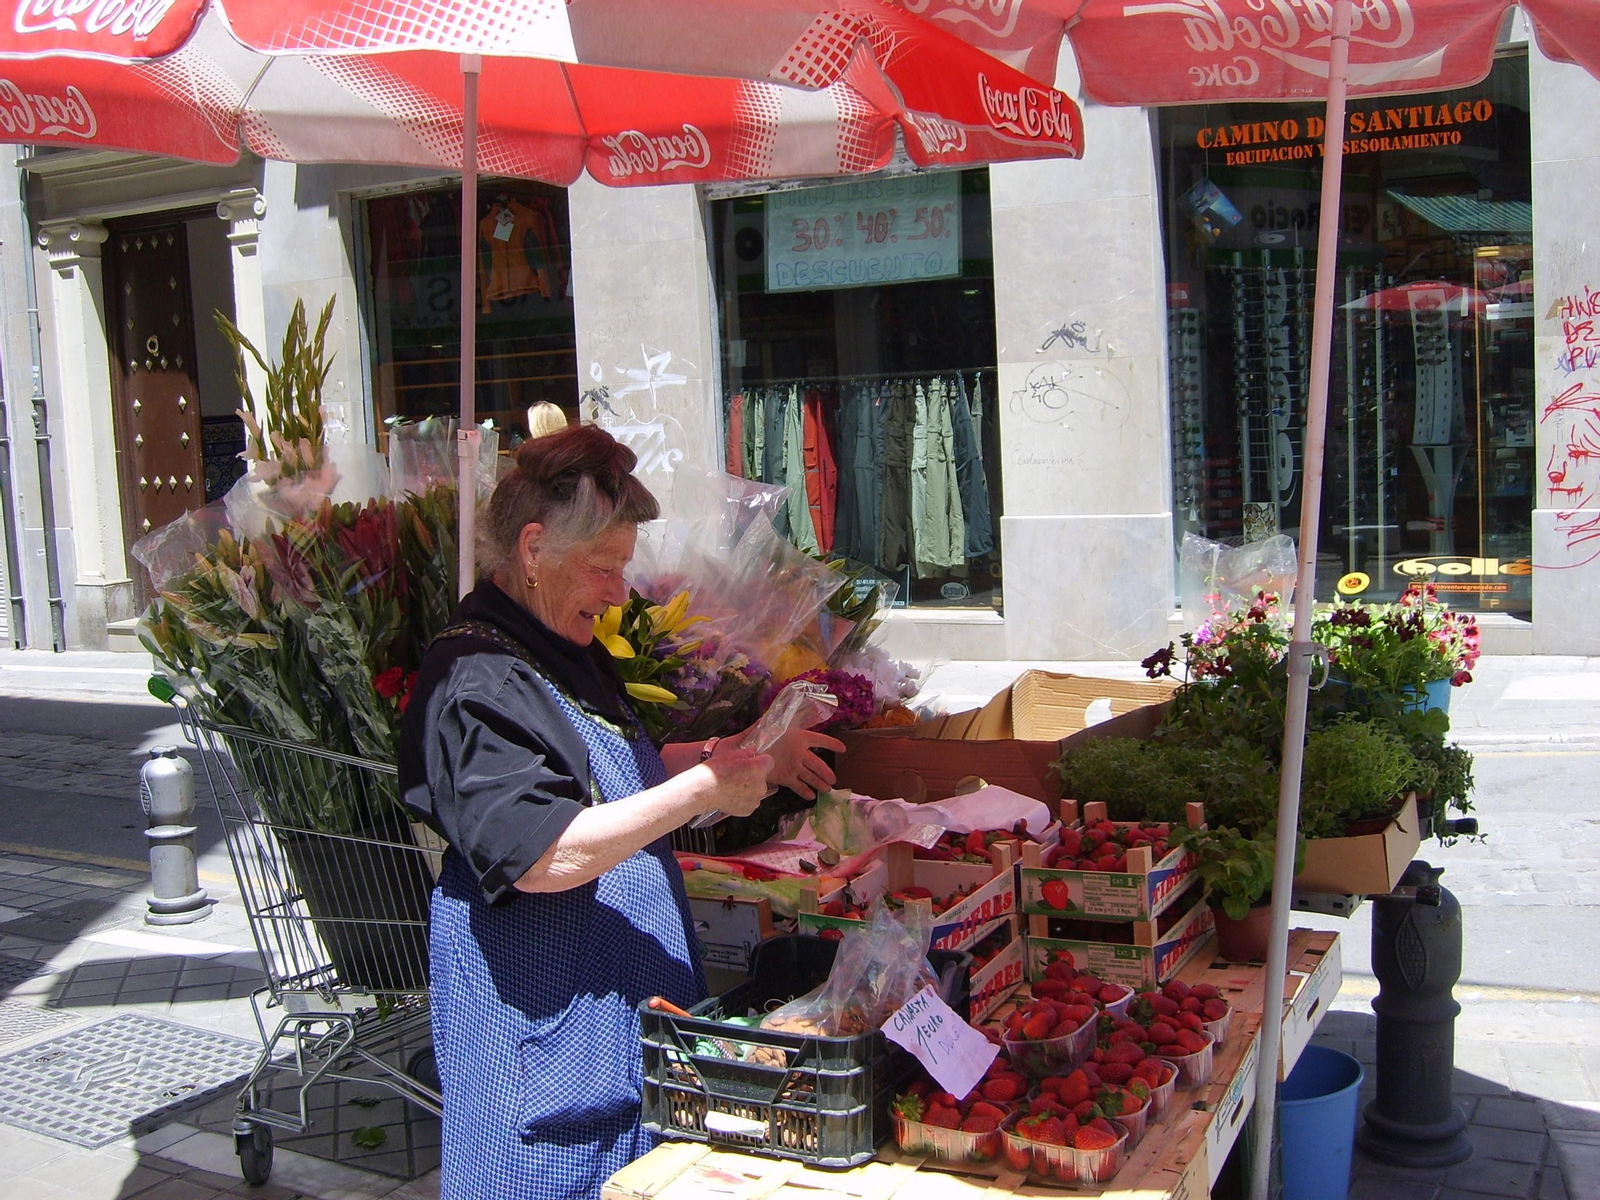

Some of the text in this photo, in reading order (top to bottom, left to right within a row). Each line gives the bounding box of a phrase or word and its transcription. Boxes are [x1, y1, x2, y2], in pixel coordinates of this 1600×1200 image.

[978, 72, 1073, 142] Coca-Cola
[1196, 97, 1493, 149] CAMINO D SANTIAGO
[1225, 143, 1313, 167] EQUIPACION
[1340, 130, 1462, 156] SESORAMIENTO
[792, 202, 955, 252] 30% 40% 50%
